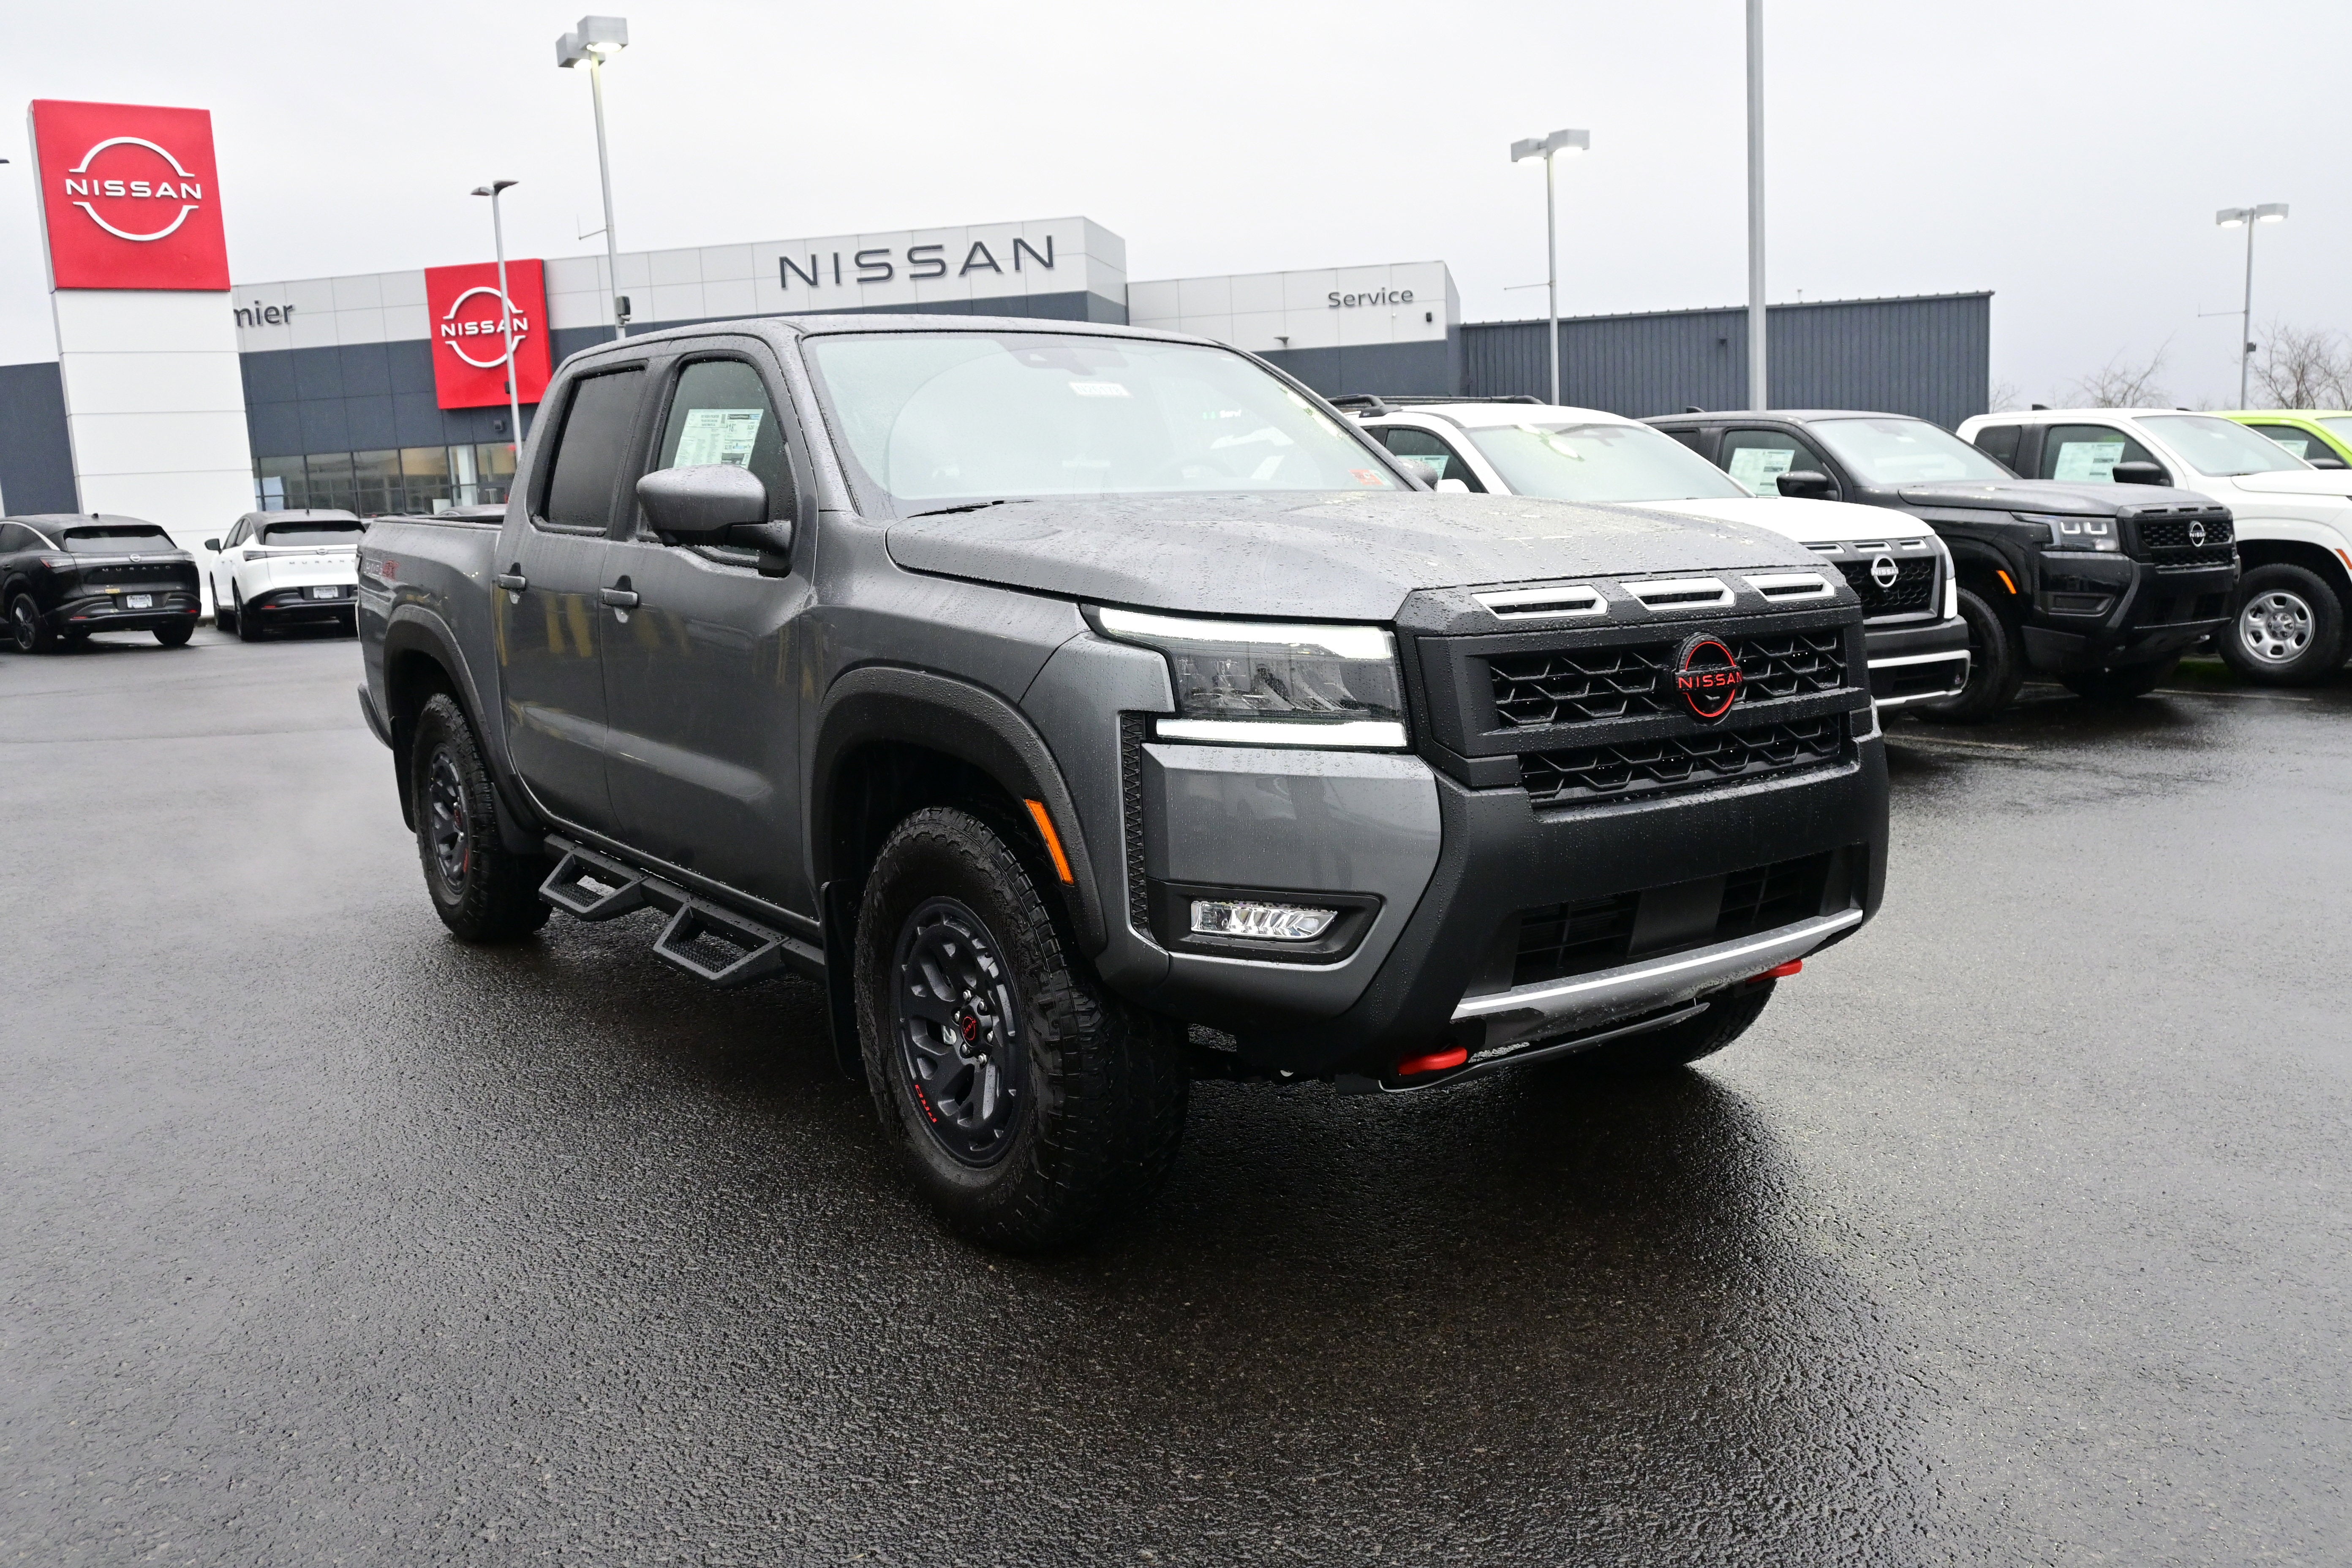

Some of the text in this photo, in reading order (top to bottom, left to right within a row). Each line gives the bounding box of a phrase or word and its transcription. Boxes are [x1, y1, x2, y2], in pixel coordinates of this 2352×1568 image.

[65, 179, 202, 199] NISSAN
[779, 235, 1054, 289] NISSAN
[1328, 287, 1414, 308] Service
[1678, 672, 1742, 689] NISSAN
